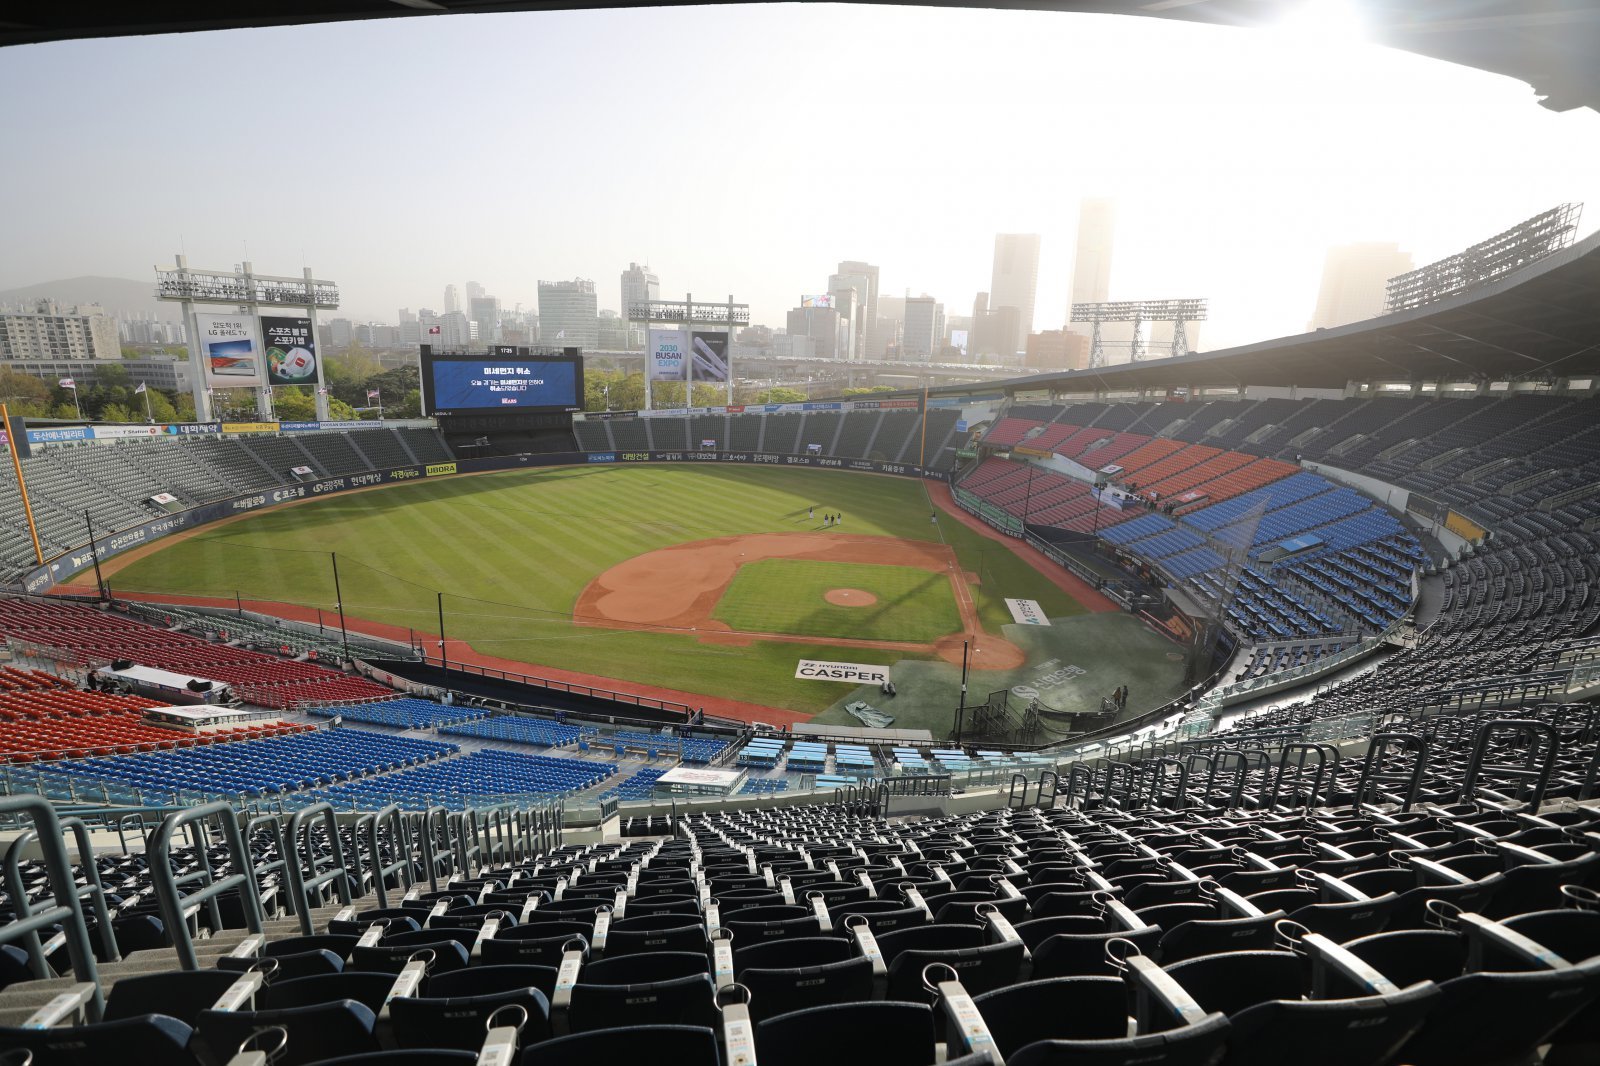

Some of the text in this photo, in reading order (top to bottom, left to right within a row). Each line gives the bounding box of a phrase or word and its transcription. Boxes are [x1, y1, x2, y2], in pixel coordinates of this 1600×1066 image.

[268, 327, 292, 336] 스포츠
[274, 336, 296, 345] 스포키
[659, 344, 678, 352] 2030
[655, 351, 682, 360] BUSAN
[483, 367, 531, 375] 미세먼지 취소
[33, 429, 85, 440] 두산에너빌리티
[427, 465, 455, 474] UBORA
[882, 464, 905, 474] 키움증권
[350, 473, 382, 486] 현대해상
[150, 517, 185, 534] 한국경제신문
[800, 668, 885, 682] CASPER
[1031, 664, 1087, 690] 신한은행
